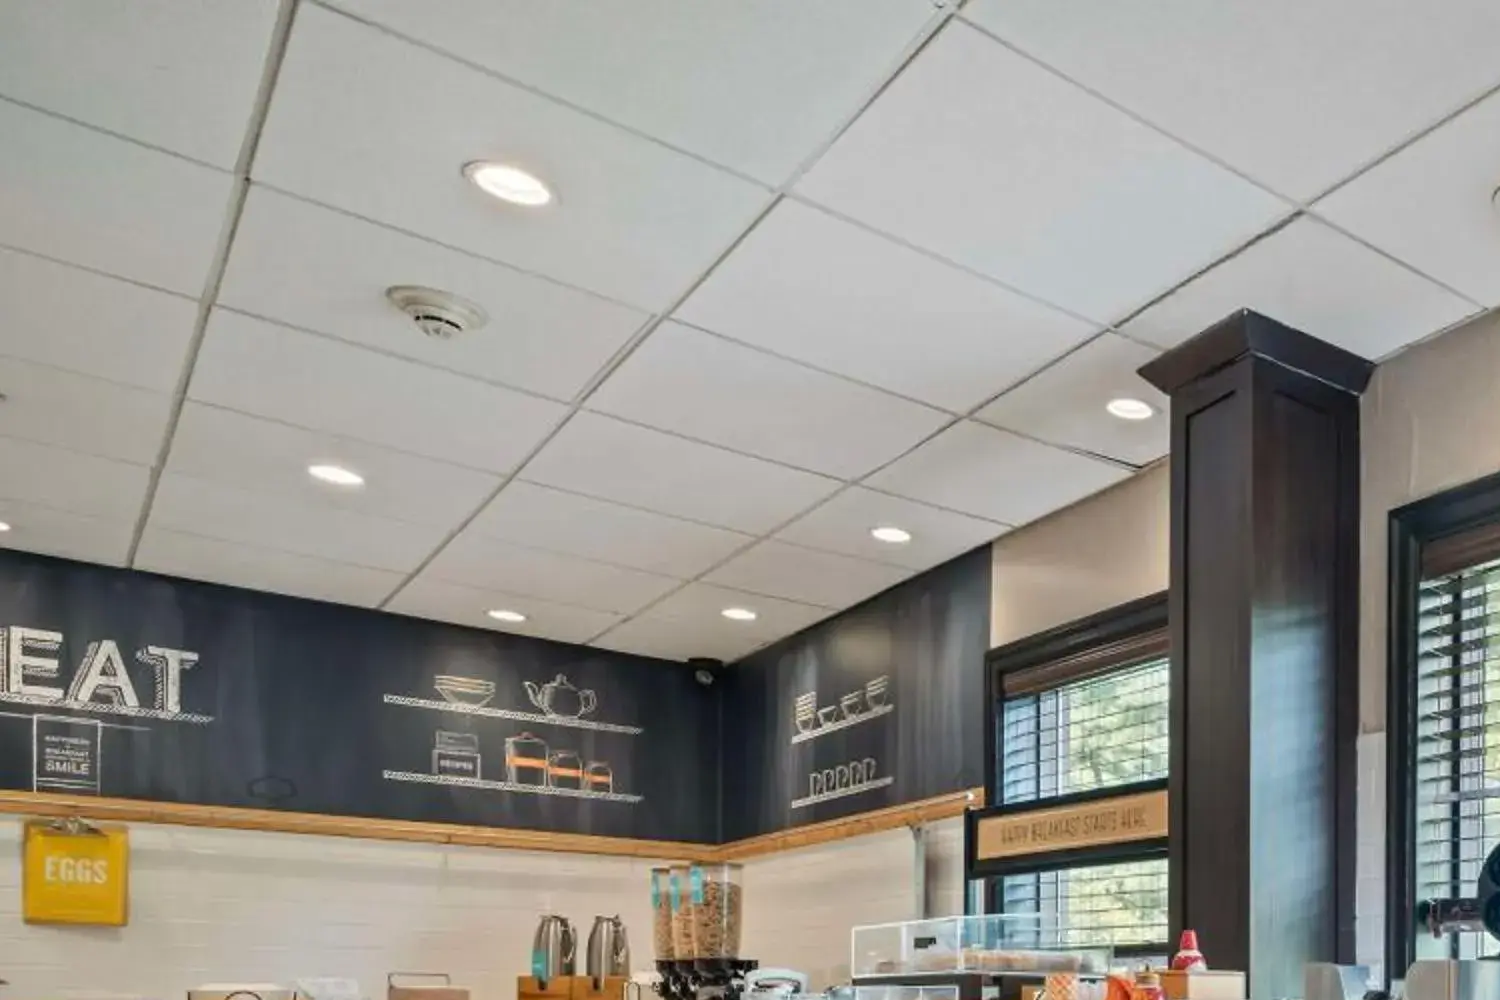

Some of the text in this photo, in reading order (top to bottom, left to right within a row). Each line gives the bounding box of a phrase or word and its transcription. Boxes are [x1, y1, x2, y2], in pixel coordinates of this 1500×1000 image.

[0, 625, 200, 714] EAT
[45, 760, 90, 775] SMILE
[44, 855, 108, 884] EGGS
